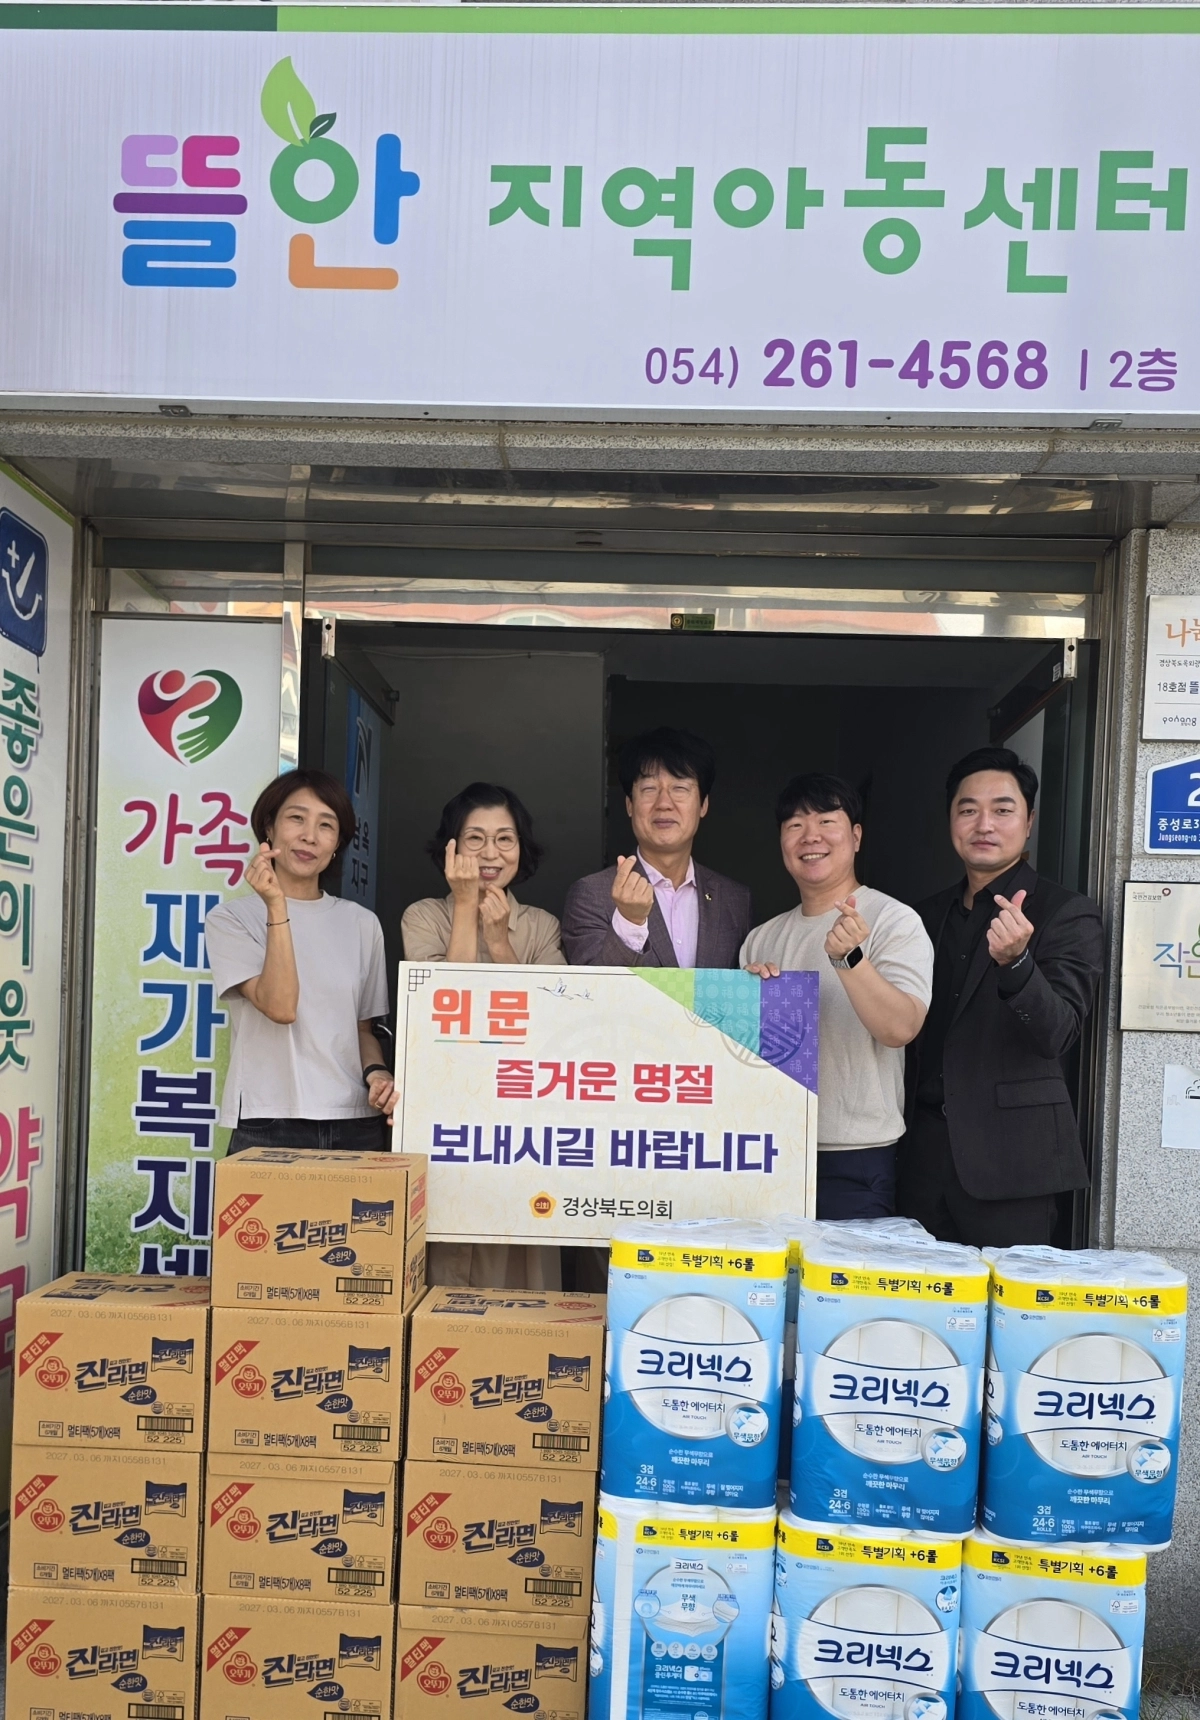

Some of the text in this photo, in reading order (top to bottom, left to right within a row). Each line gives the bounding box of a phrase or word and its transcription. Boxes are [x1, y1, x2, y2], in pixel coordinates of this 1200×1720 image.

[113, 127, 1188, 293] 뜰안 지역아동센터
[645, 339, 1179, 392] 054) 261-4568 2층
[1157, 681, 1187, 693] 18호점
[123, 791, 251, 886] 가족
[496, 1059, 713, 1105] 즐거운 명절
[430, 1123, 778, 1174] 보내시길 바랍니다
[221, 1196, 250, 1225] 멀티팩
[562, 1197, 673, 1219] 경상북도의회
[274, 1220, 348, 1254] 진라면
[327, 1250, 351, 1264] 순한맛
[680, 1253, 723, 1268] 특별기획
[728, 1258, 755, 1271] +6롤
[876, 1278, 954, 1296] 특별기획 +6롤
[1083, 1293, 1160, 1309] 특별기획 +6롤
[21, 1334, 50, 1363] 멀티팩
[218, 1343, 247, 1372] 멀티팩
[75, 1358, 148, 1392] 진라면
[417, 1349, 447, 1379] 멀티팩
[637, 1349, 753, 1382] 크리넥스
[128, 1389, 152, 1402] 순한맛
[271, 1366, 345, 1401] 진라면
[470, 1375, 544, 1409] 진라면
[830, 1374, 950, 1407] 크리넥스
[324, 1397, 348, 1410] 순한맛
[524, 1406, 548, 1419] 순한맛
[662, 1399, 726, 1413] 도톰한 에어터치
[1034, 1391, 1156, 1420] 크리넥스
[855, 1424, 921, 1437] 도톰한 에어터치
[1060, 1440, 1127, 1452] 도톰한 에어터치
[17, 1477, 45, 1506] 멀티팩
[213, 1485, 242, 1514] 멀티팩
[69, 1501, 141, 1535] 진라면
[410, 1495, 439, 1524] 멀티팩
[122, 1532, 146, 1545] 순한맛
[266, 1510, 339, 1543] 진라면
[462, 1520, 536, 1553] 진라면
[679, 1529, 739, 1542] 특별기획 +6롤
[319, 1542, 343, 1554] 순한맛
[516, 1551, 540, 1564] 순한맛
[861, 1545, 938, 1563] 특별기획 +6롤
[675, 1562, 704, 1570] 크리넥스
[1038, 1559, 1118, 1580] 특별기획 +6롤
[13, 1622, 42, 1651] 멀티팩
[209, 1630, 238, 1659] 멀티팩
[66, 1645, 139, 1679] 진라면
[404, 1639, 432, 1668] 멀티팩
[814, 1640, 933, 1672] 크리넥스
[119, 1677, 142, 1689] 순한맛
[262, 1654, 335, 1688] 진라면
[457, 1665, 531, 1699] 진라면
[991, 1652, 1114, 1688] 크리넥스
[315, 1685, 339, 1698] 순한맛
[511, 1697, 535, 1709] 순한맛
[839, 1688, 905, 1702] 도톰한 에어터치
[1017, 1702, 1084, 1718] 도톰한 에어터치
